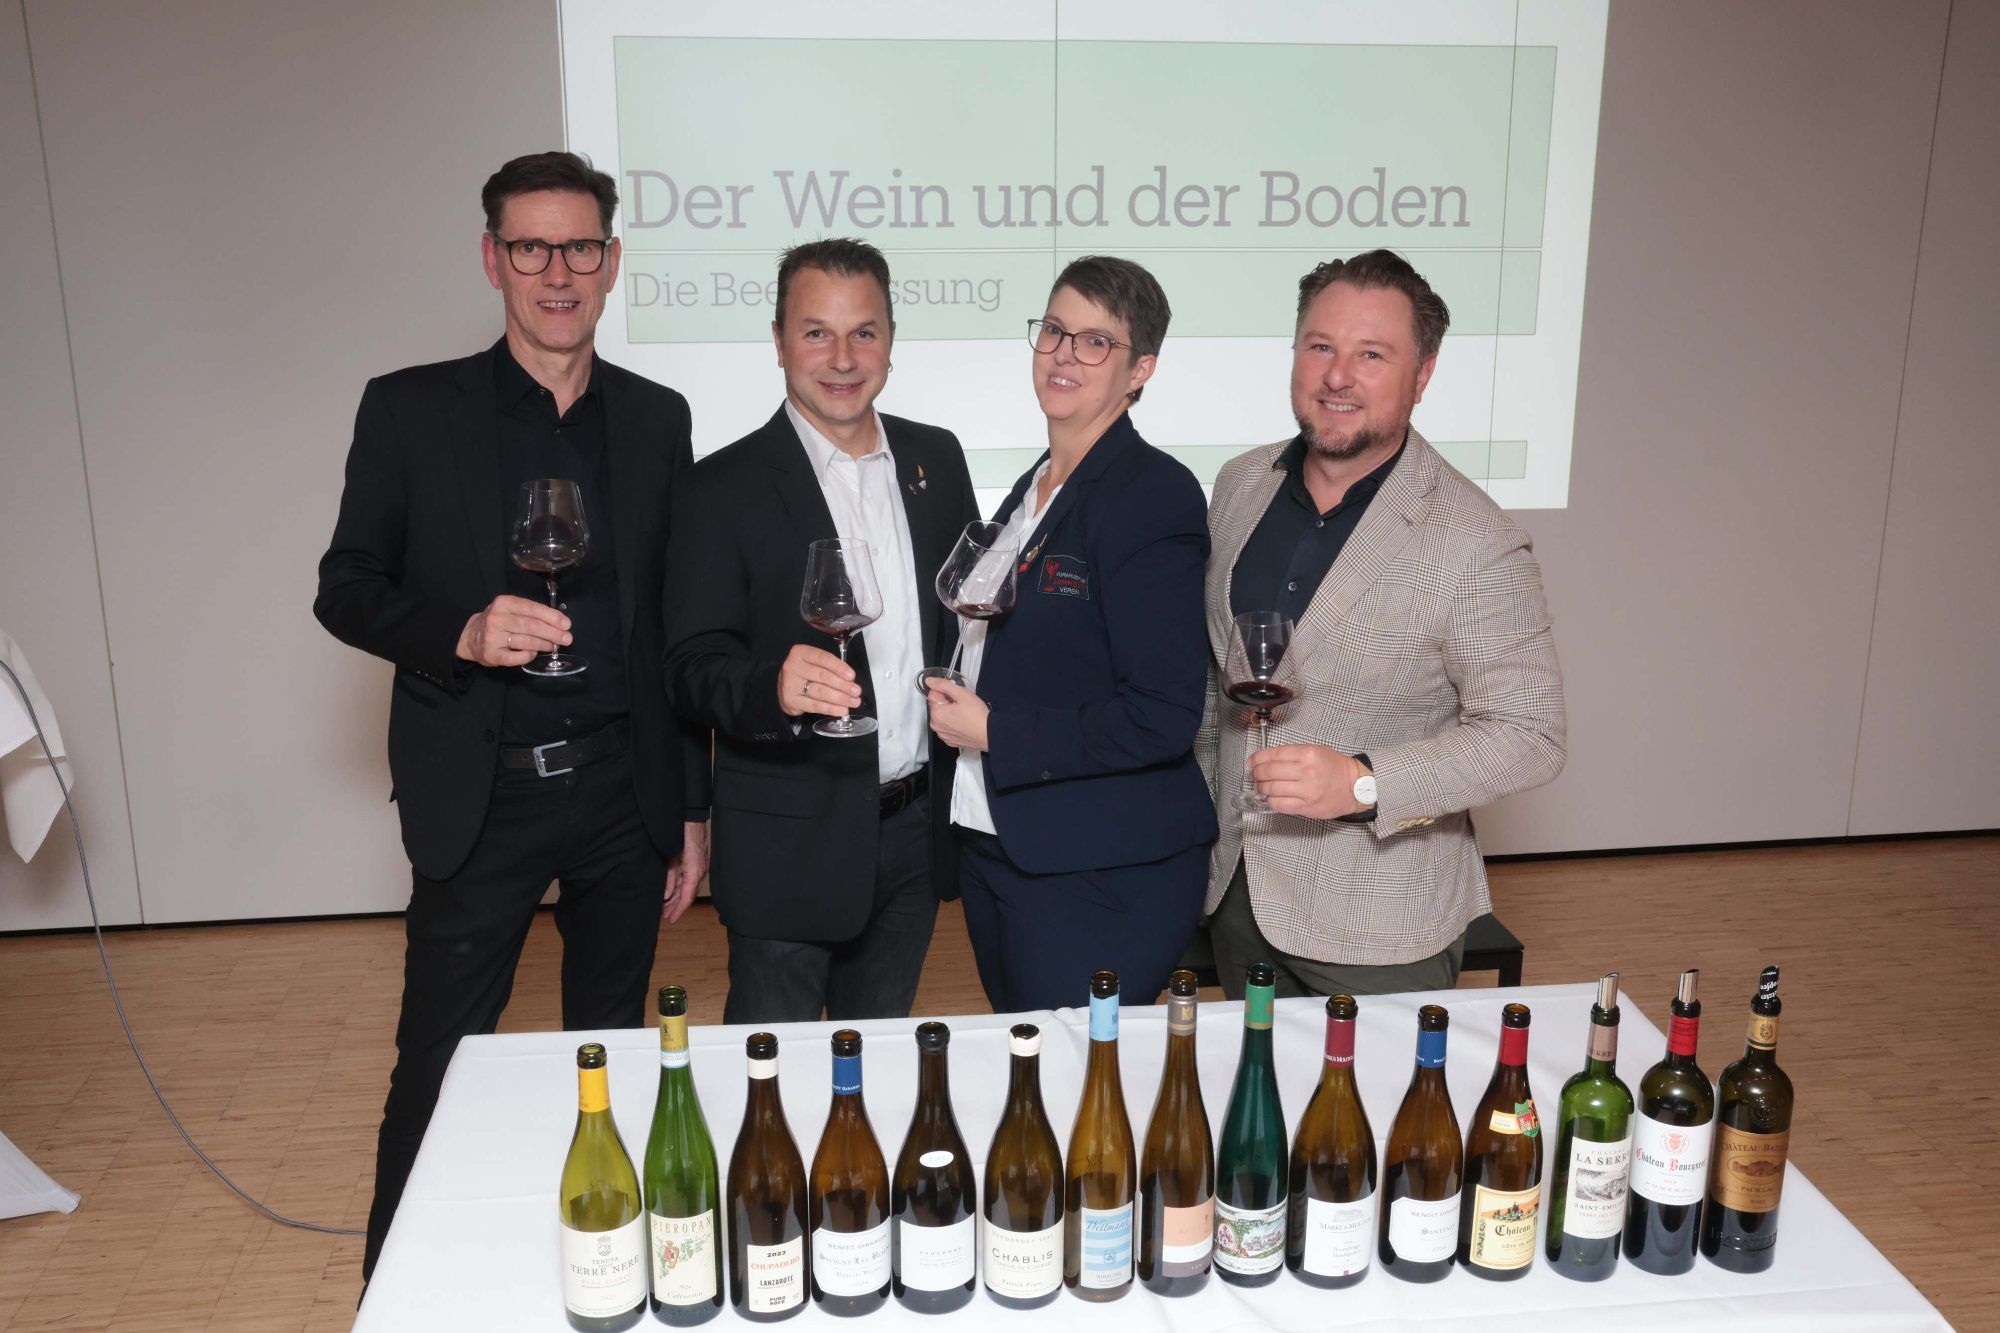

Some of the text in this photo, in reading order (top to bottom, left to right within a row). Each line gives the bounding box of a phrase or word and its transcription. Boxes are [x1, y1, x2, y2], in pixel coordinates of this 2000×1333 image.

[626, 165, 1471, 229] Der Wein und der Boden
[629, 271, 699, 307] Die
[1576, 1152, 1592, 1165] LA
[653, 1215, 712, 1234] PIEROPAN
[1494, 1224, 1531, 1237] Château
[592, 1256, 620, 1265] TENUTA
[750, 1255, 801, 1271] CHUPADERO
[991, 1247, 1054, 1264] CHABLIS
[569, 1253, 641, 1277] TERRE NERE
[760, 1274, 795, 1287] LANZAROTE
